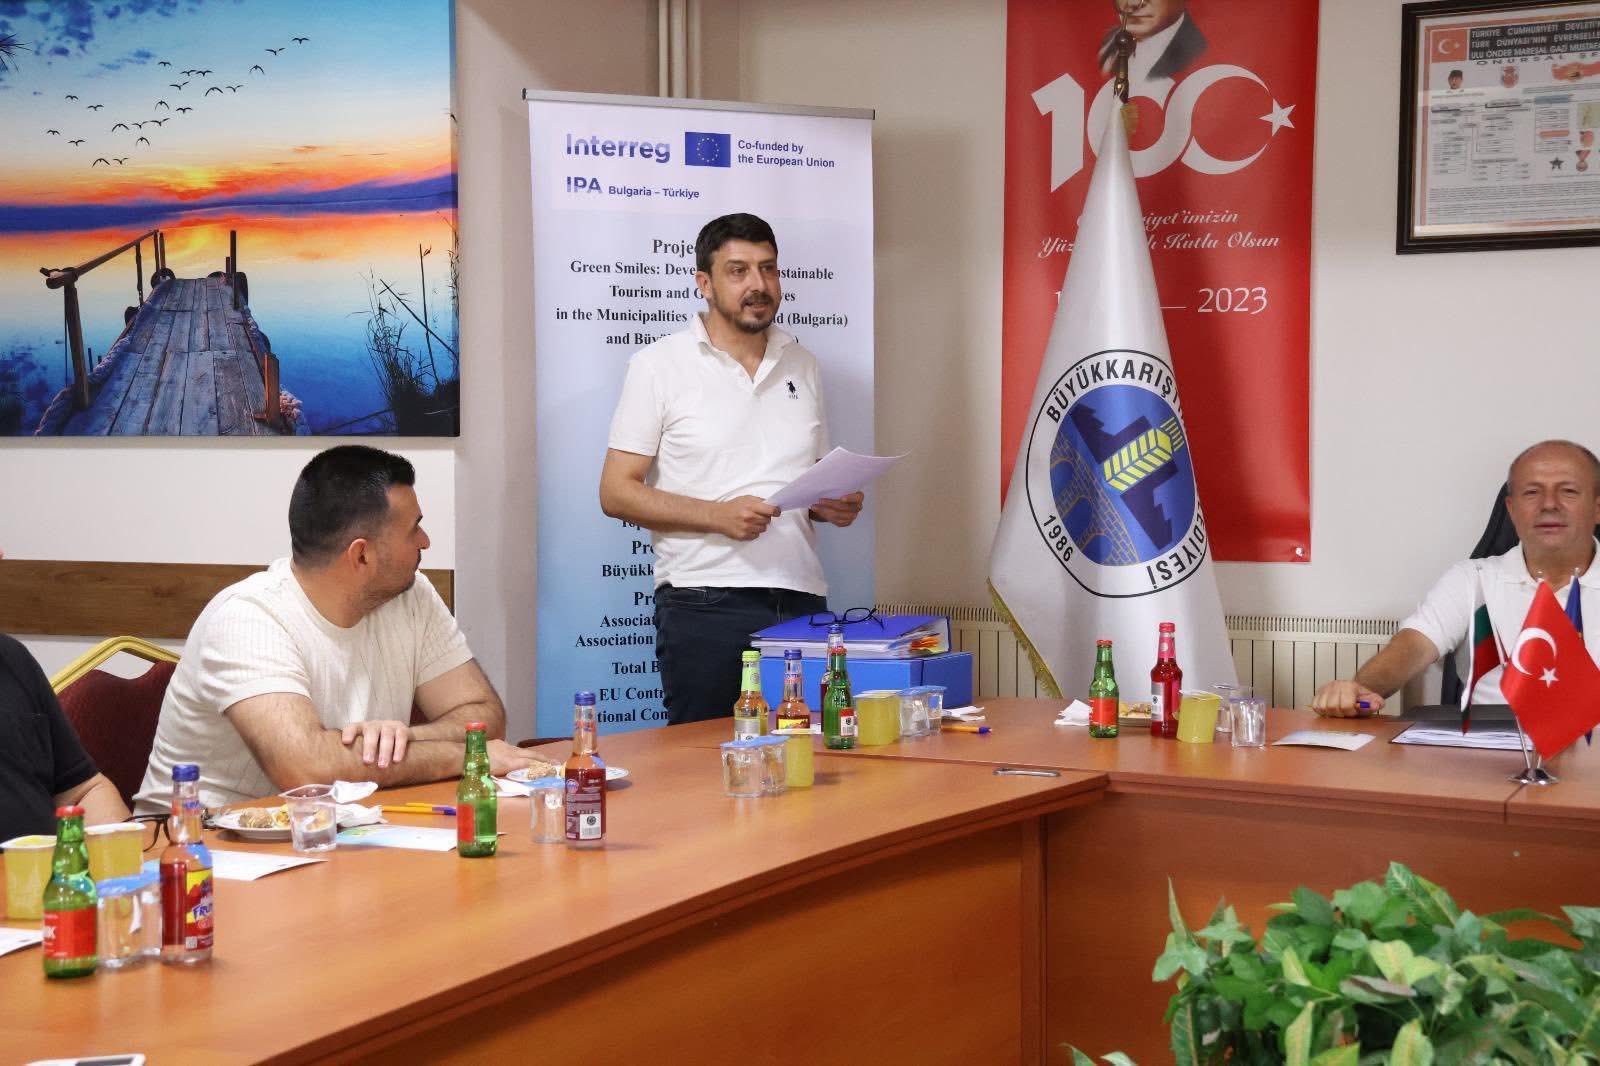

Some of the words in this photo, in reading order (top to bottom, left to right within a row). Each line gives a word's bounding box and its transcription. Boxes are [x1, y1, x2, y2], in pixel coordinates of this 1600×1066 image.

[566, 133, 671, 163] Interreg
[738, 140, 789, 152] Co-funded
[791, 143, 804, 155] by
[738, 155, 754, 164] the
[756, 156, 803, 167] European
[806, 157, 835, 168] Union
[566, 176, 603, 193] IPA
[608, 185, 652, 197] Bulgaria
[662, 186, 700, 199] Türkiye
[652, 238, 698, 258] Proje
[1038, 237, 1075, 258] Yüz
[1163, 231, 1219, 250] Kutlu
[1227, 230, 1281, 248] Olsun
[570, 260, 611, 273] Green
[615, 262, 660, 275] Smiles:
[665, 263, 696, 276] Deve
[610, 285, 662, 298] Tourism
[666, 287, 690, 299] and
[1198, 286, 1268, 315] 2023
[556, 308, 568, 320] in
[572, 308, 593, 321] the
[597, 308, 688, 324] Municipalities
[787, 312, 849, 328] (Bulgaria)
[606, 333, 630, 345] and
[1044, 514, 1074, 563] 1986
[600, 614, 656, 628] Associat
[575, 633, 653, 647] Association
[612, 661, 646, 675] Total
[599, 688, 621, 701] EU
[597, 710, 636, 724] tional
